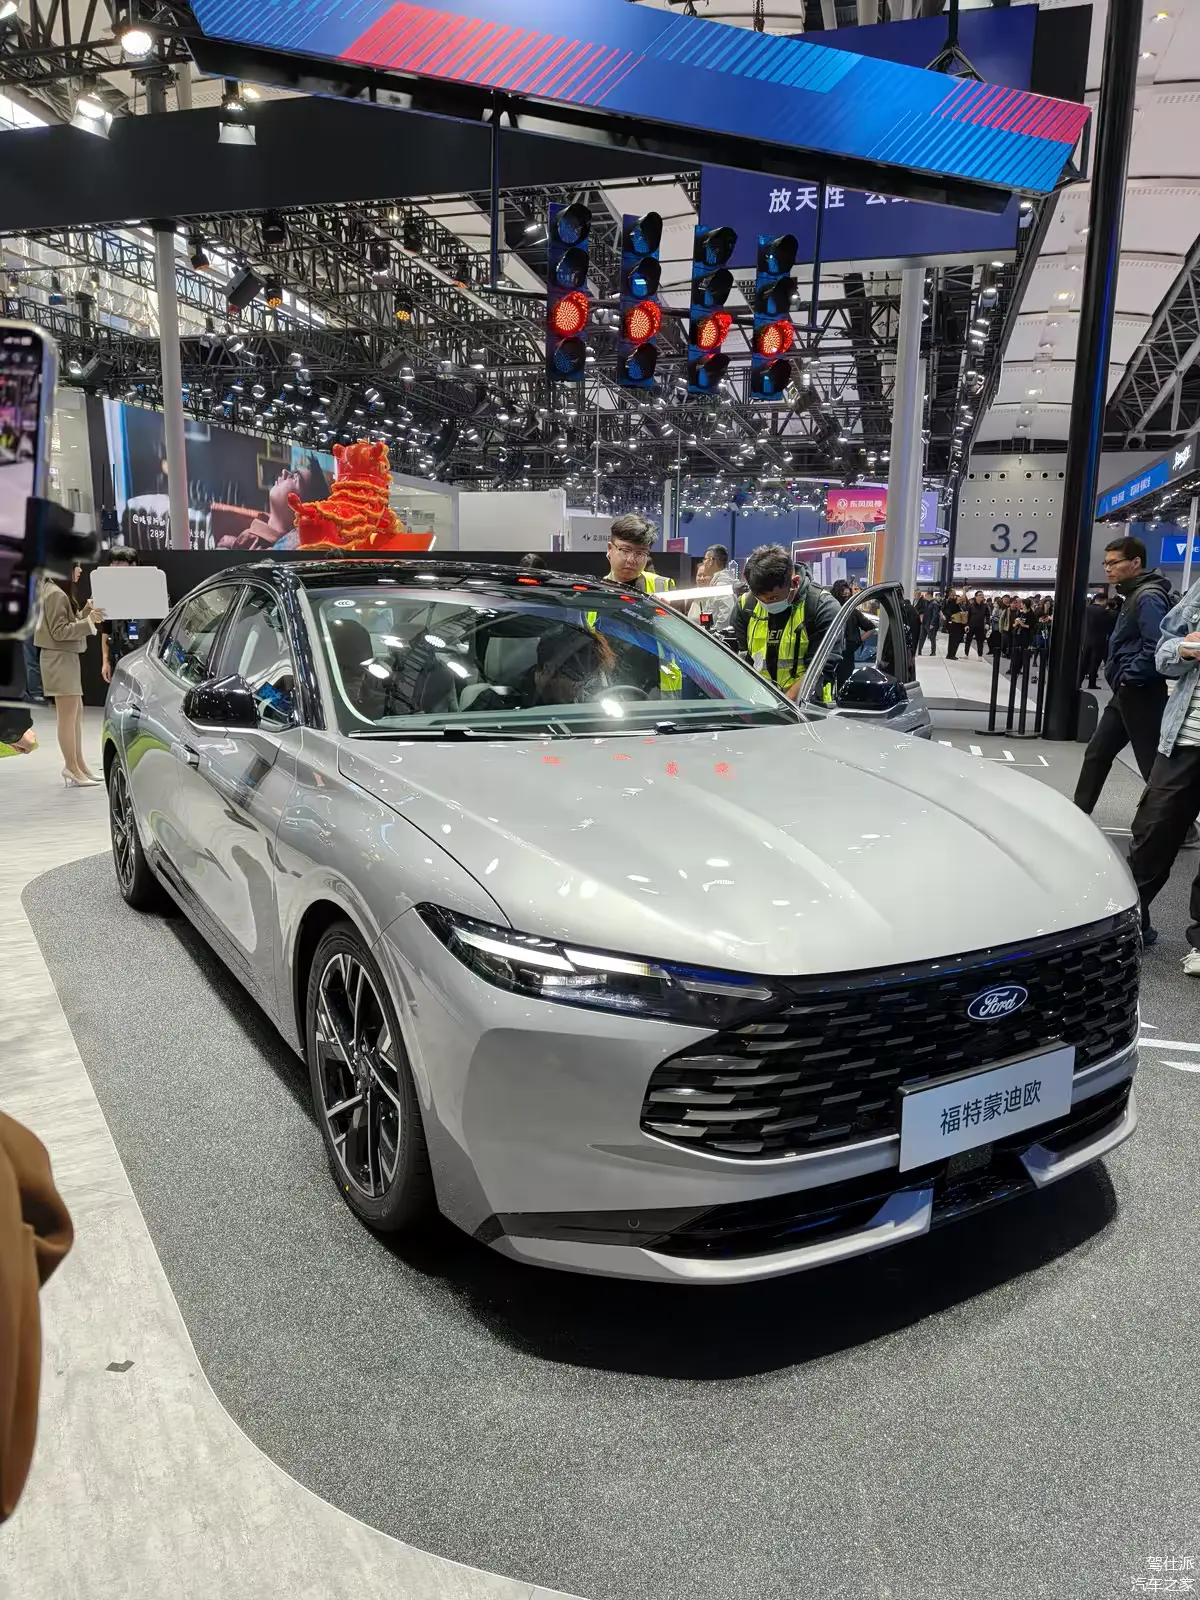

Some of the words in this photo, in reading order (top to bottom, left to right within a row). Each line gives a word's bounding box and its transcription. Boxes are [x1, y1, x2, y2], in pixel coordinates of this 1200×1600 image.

[850, 500, 882, 508] 东风风神
[990, 523, 1038, 553] 3.2
[979, 991, 1018, 1016] Ford
[940, 1079, 1042, 1136] 福特蒙迪欧
